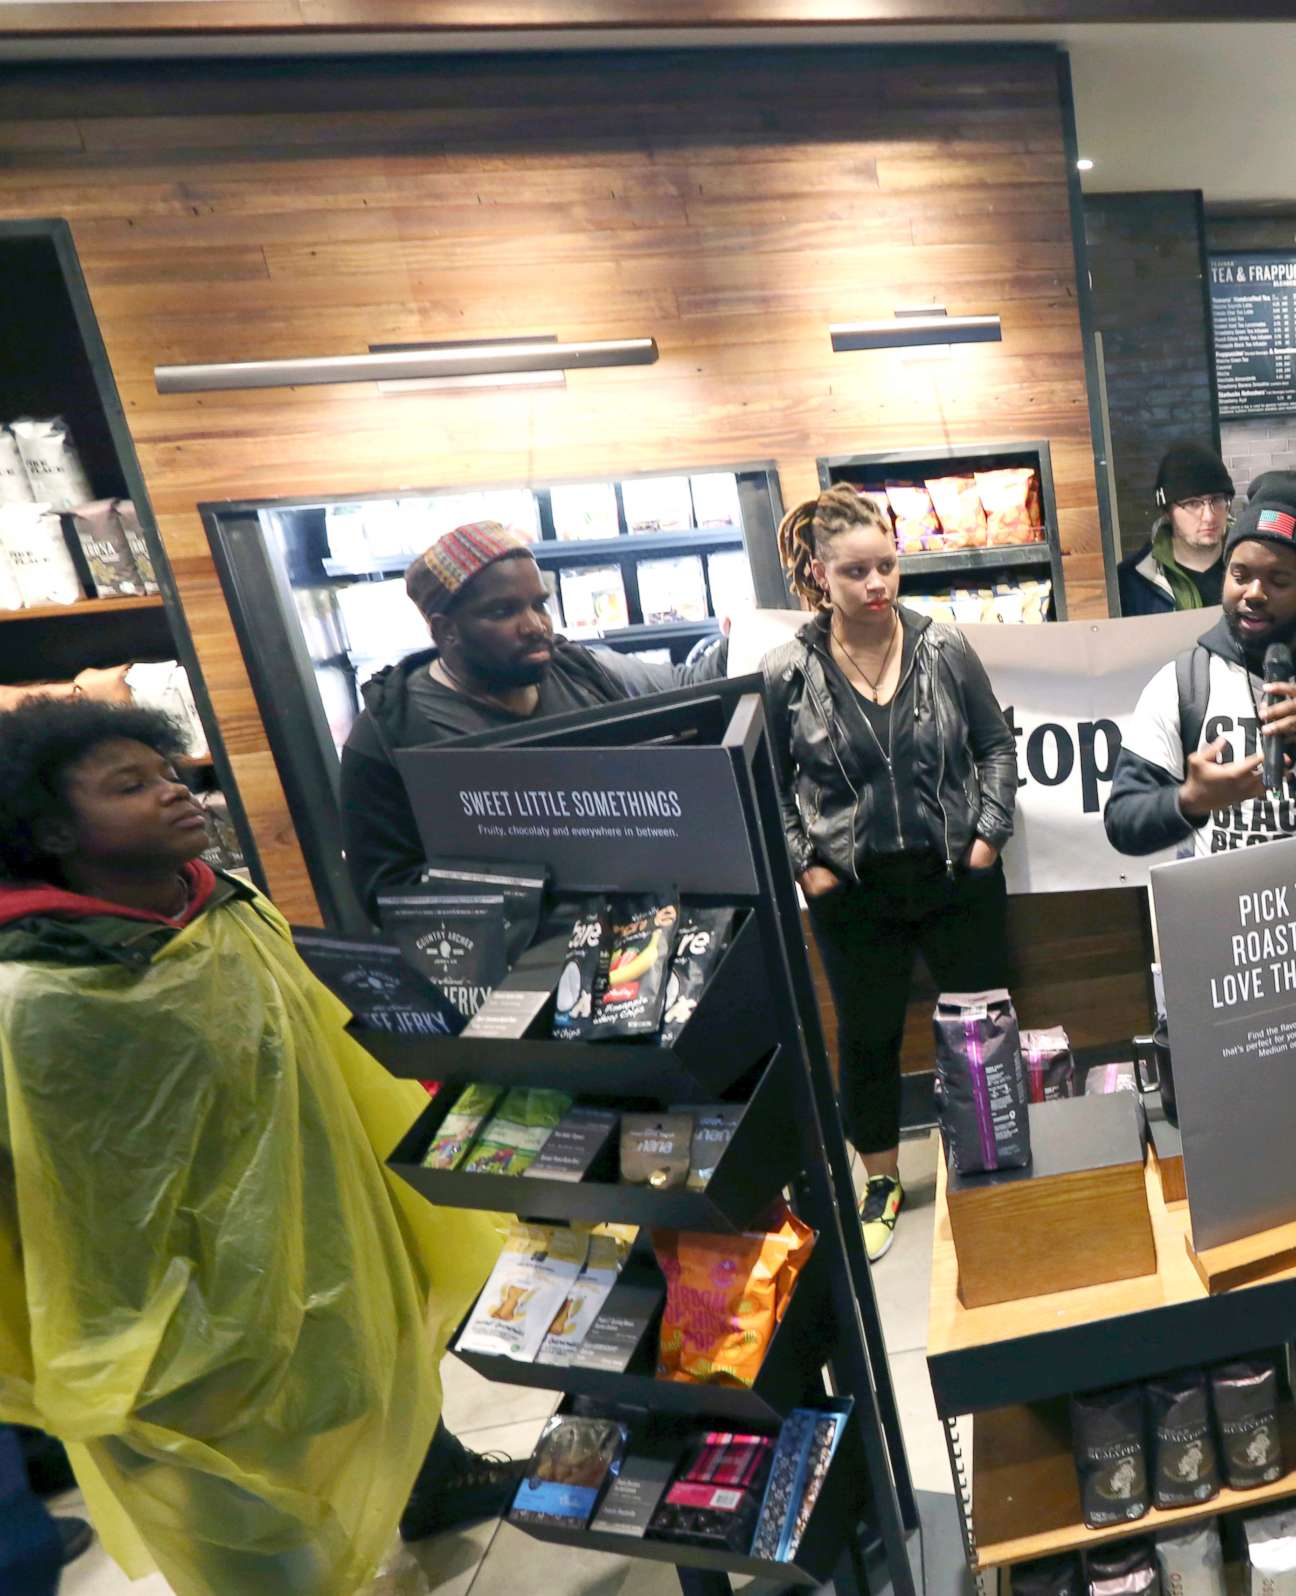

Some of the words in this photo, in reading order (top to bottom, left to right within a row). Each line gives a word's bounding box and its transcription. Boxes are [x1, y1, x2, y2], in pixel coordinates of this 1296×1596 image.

[1211, 268, 1234, 283] TEA
[1236, 266, 1246, 282] &
[1002, 705, 1122, 813] top
[460, 791, 513, 817] SWEET
[514, 791, 571, 817] LITTLE
[571, 790, 682, 817] SOMETHINGS
[508, 825, 551, 838] chocolaty
[552, 825, 570, 836] and
[571, 825, 621, 838] everywhere
[624, 825, 634, 836] in
[636, 824, 679, 837] between.
[1239, 886, 1290, 927] PICK
[1211, 968, 1264, 1009] LOVE
[1222, 1044, 1244, 1057] that's
[1246, 1038, 1273, 1053] perfect
[1274, 1034, 1285, 1044] for
[1247, 1030, 1264, 1041] Find
[1266, 1027, 1279, 1036] the
[1258, 1043, 1288, 1057] Medium
